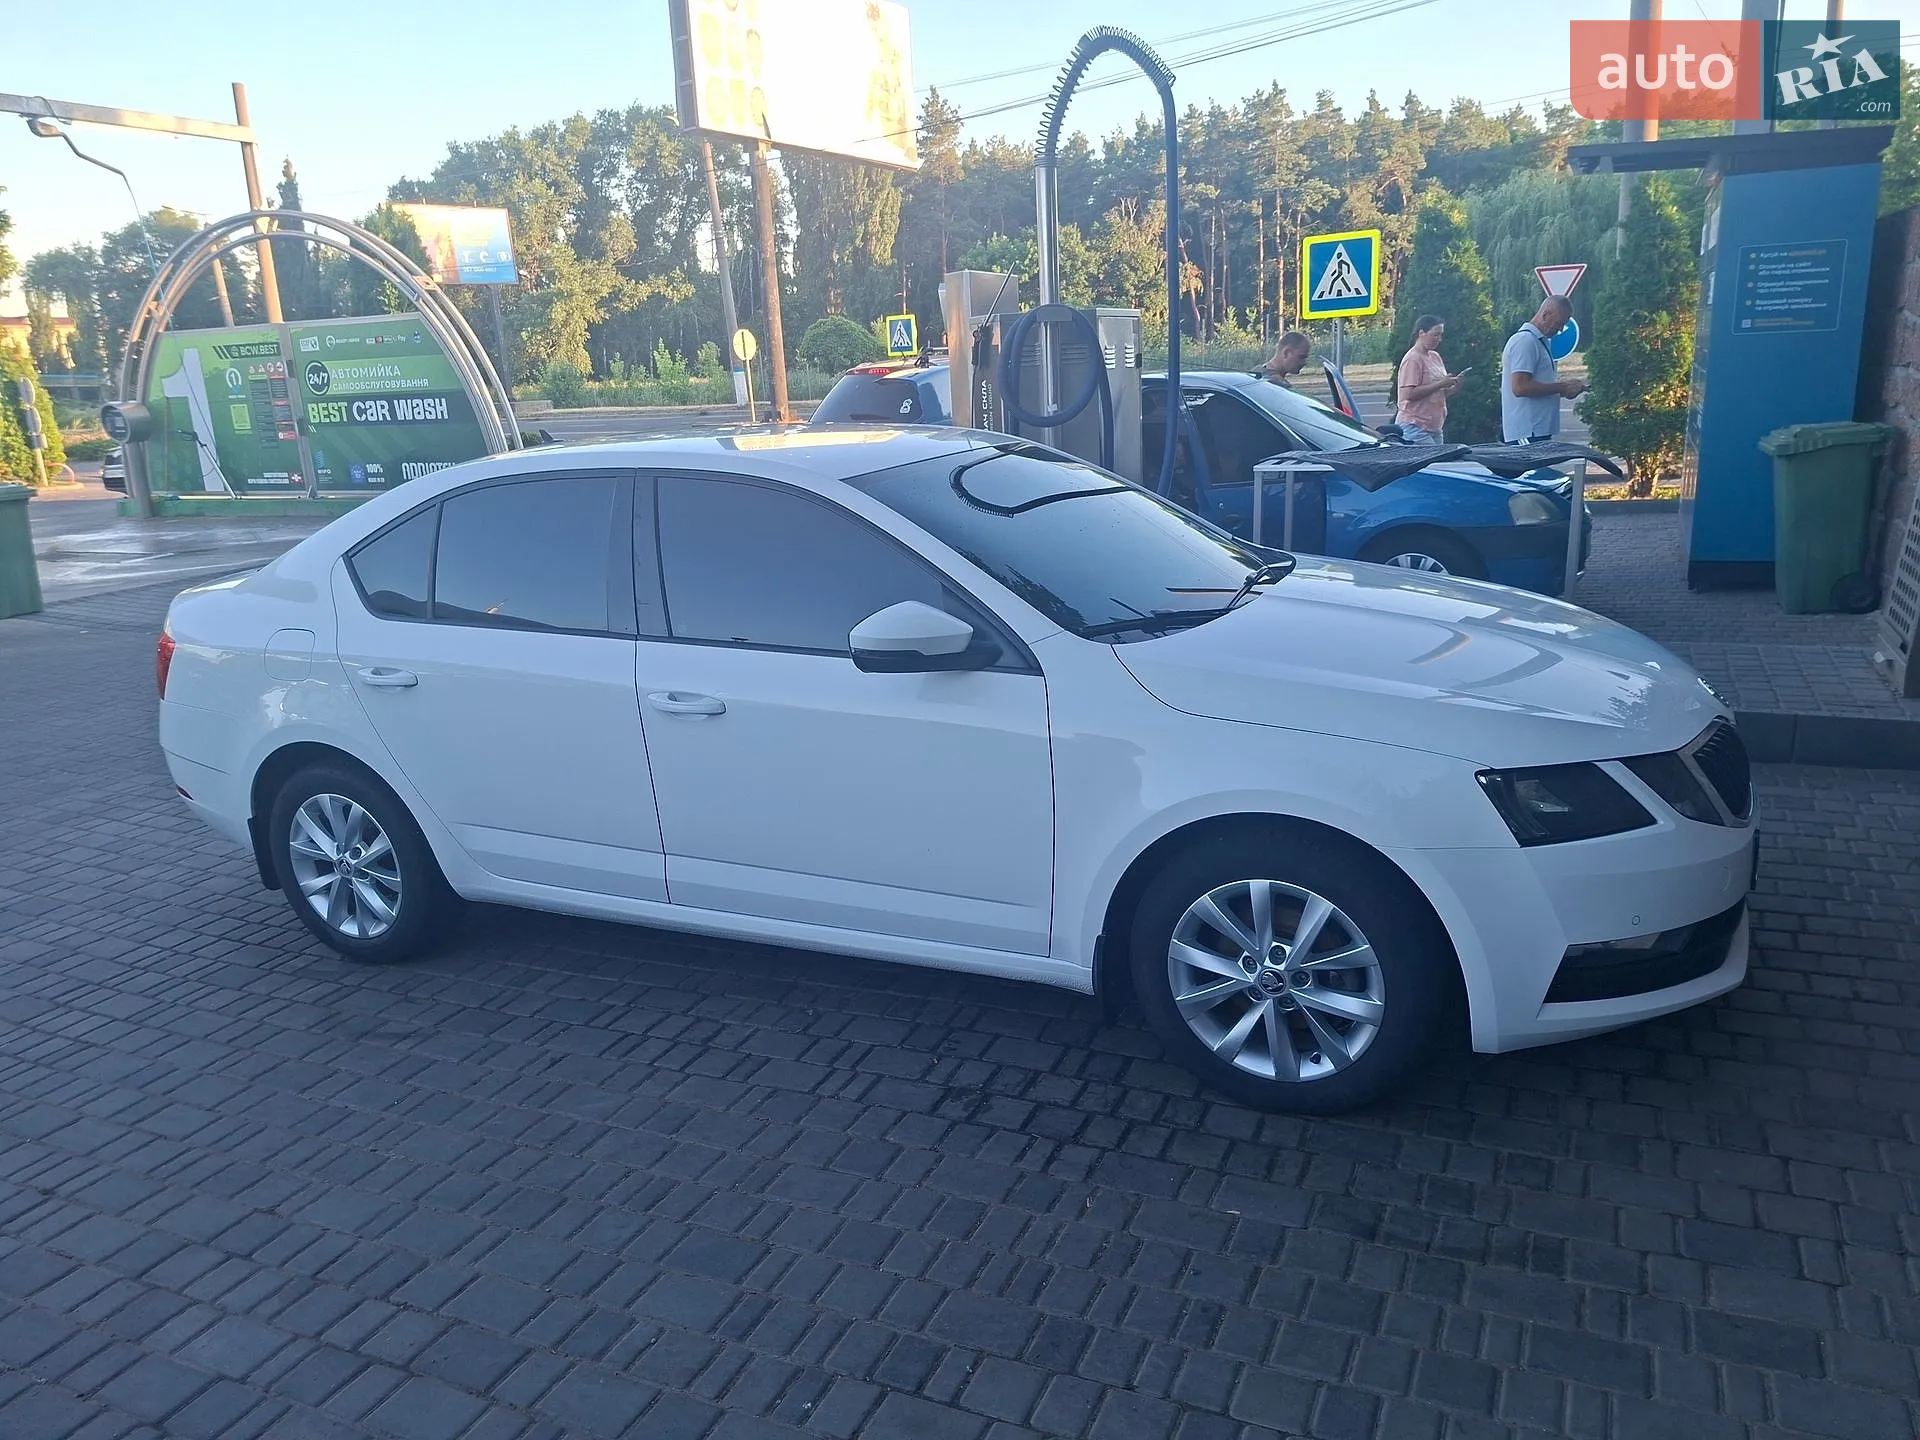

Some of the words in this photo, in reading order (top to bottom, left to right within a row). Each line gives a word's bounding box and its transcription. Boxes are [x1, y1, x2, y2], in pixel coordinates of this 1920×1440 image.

[308, 371, 328, 386] 24/7
[331, 364, 401, 379] АВТОМИЙКА
[333, 378, 429, 391] САМООБСЛУГОВУВАННЯ
[307, 401, 348, 423] BEST
[366, 463, 384, 473] 100%
